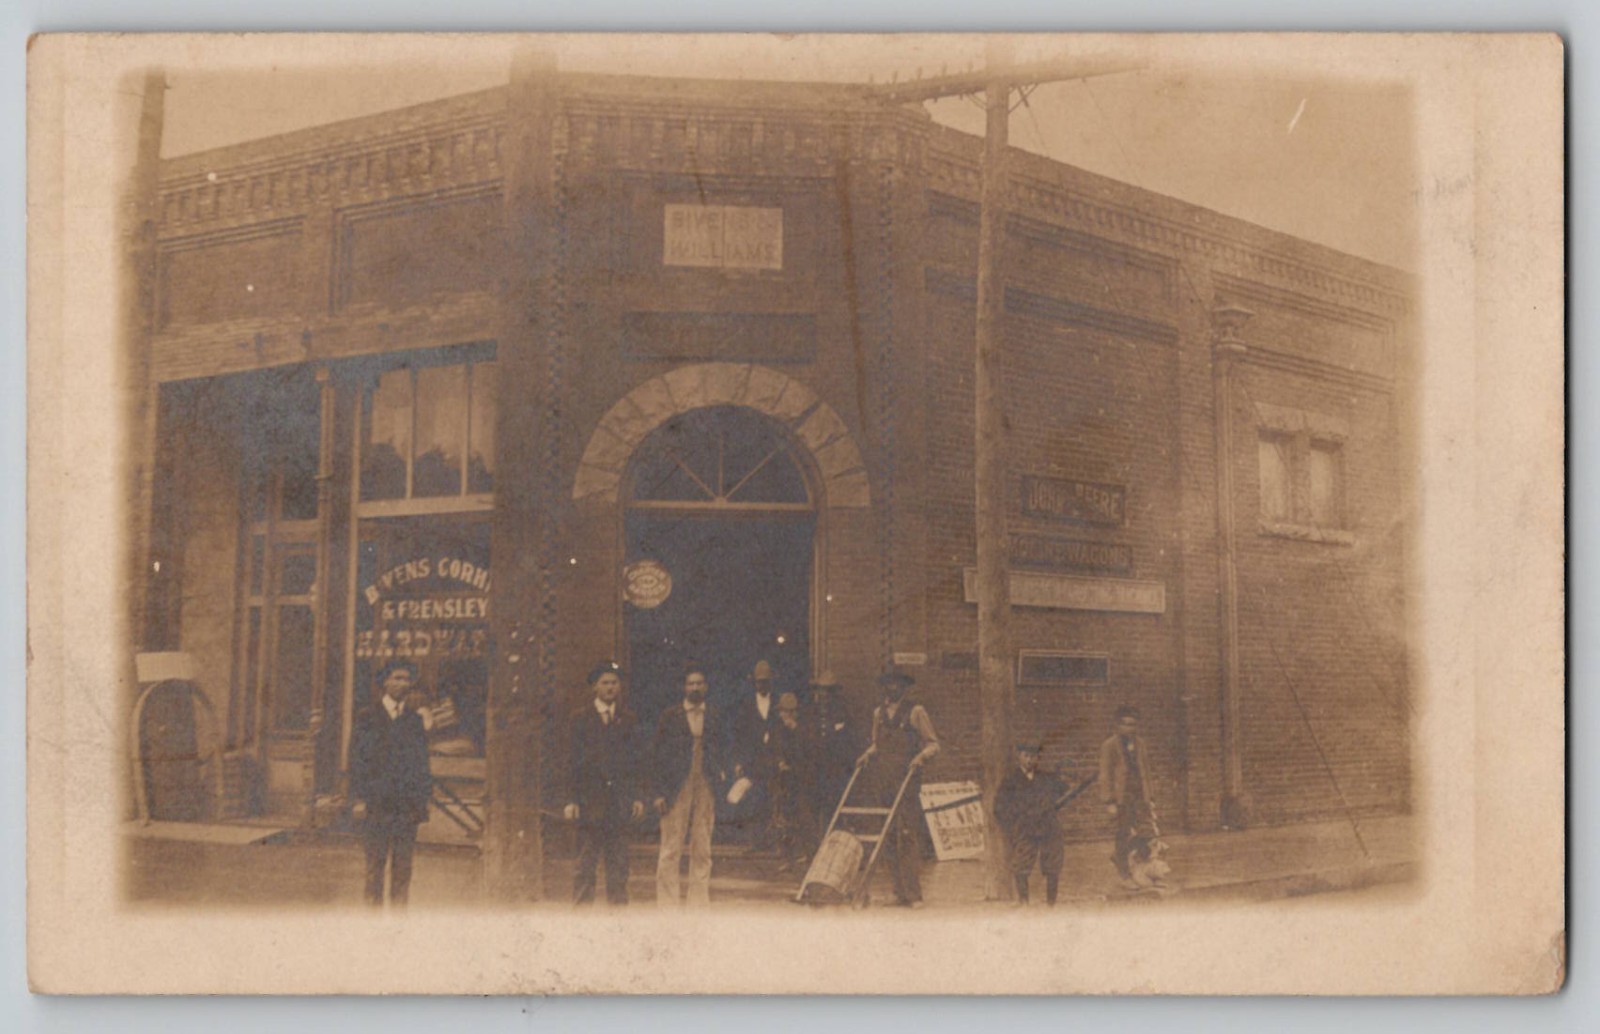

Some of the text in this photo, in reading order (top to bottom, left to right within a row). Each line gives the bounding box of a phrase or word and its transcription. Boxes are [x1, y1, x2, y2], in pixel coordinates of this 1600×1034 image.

[671, 209, 751, 231] BIVES
[1066, 541, 1128, 567] WAGONS
[365, 558, 430, 605] BVENS
[382, 598, 488, 619] & FRENSLEY
